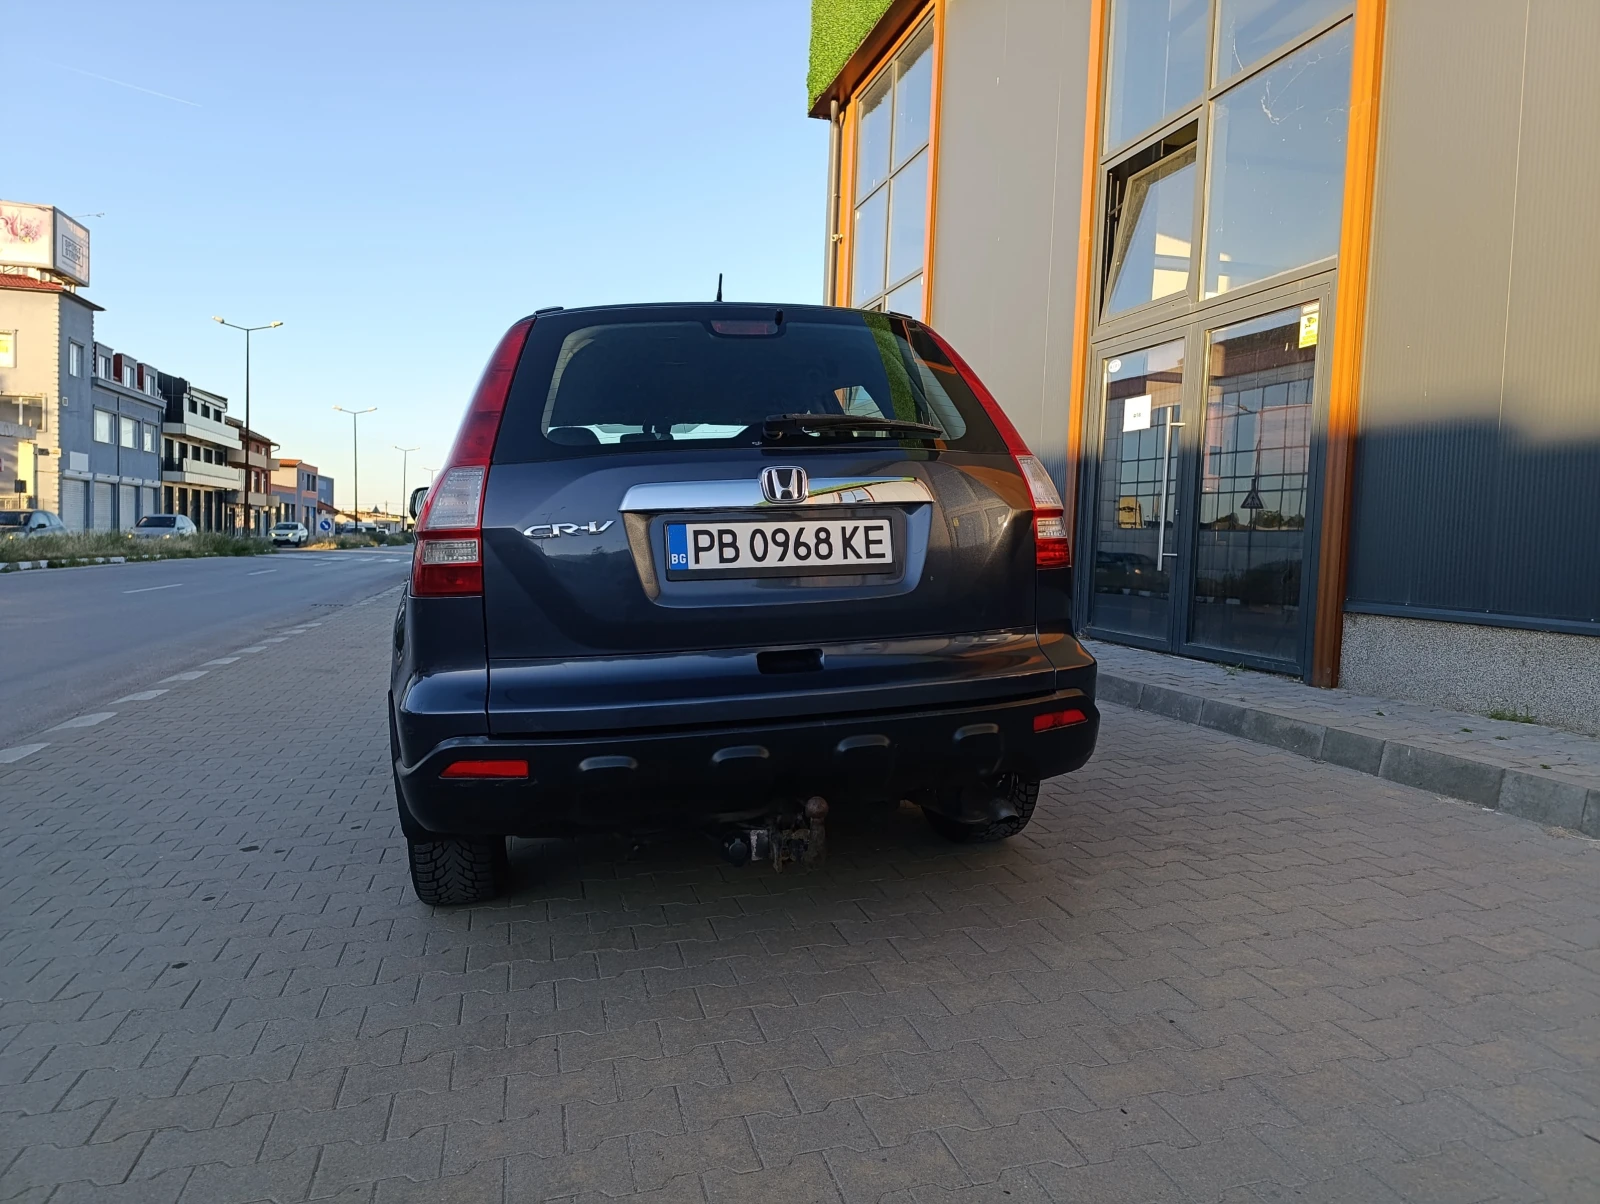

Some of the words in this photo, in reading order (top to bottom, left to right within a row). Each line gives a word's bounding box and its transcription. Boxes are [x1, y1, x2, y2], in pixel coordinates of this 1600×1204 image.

[523, 520, 616, 539] CR-V
[693, 529, 740, 565] PB
[749, 527, 833, 563] 0968
[841, 525, 886, 560] KE
[671, 554, 687, 565] BG
